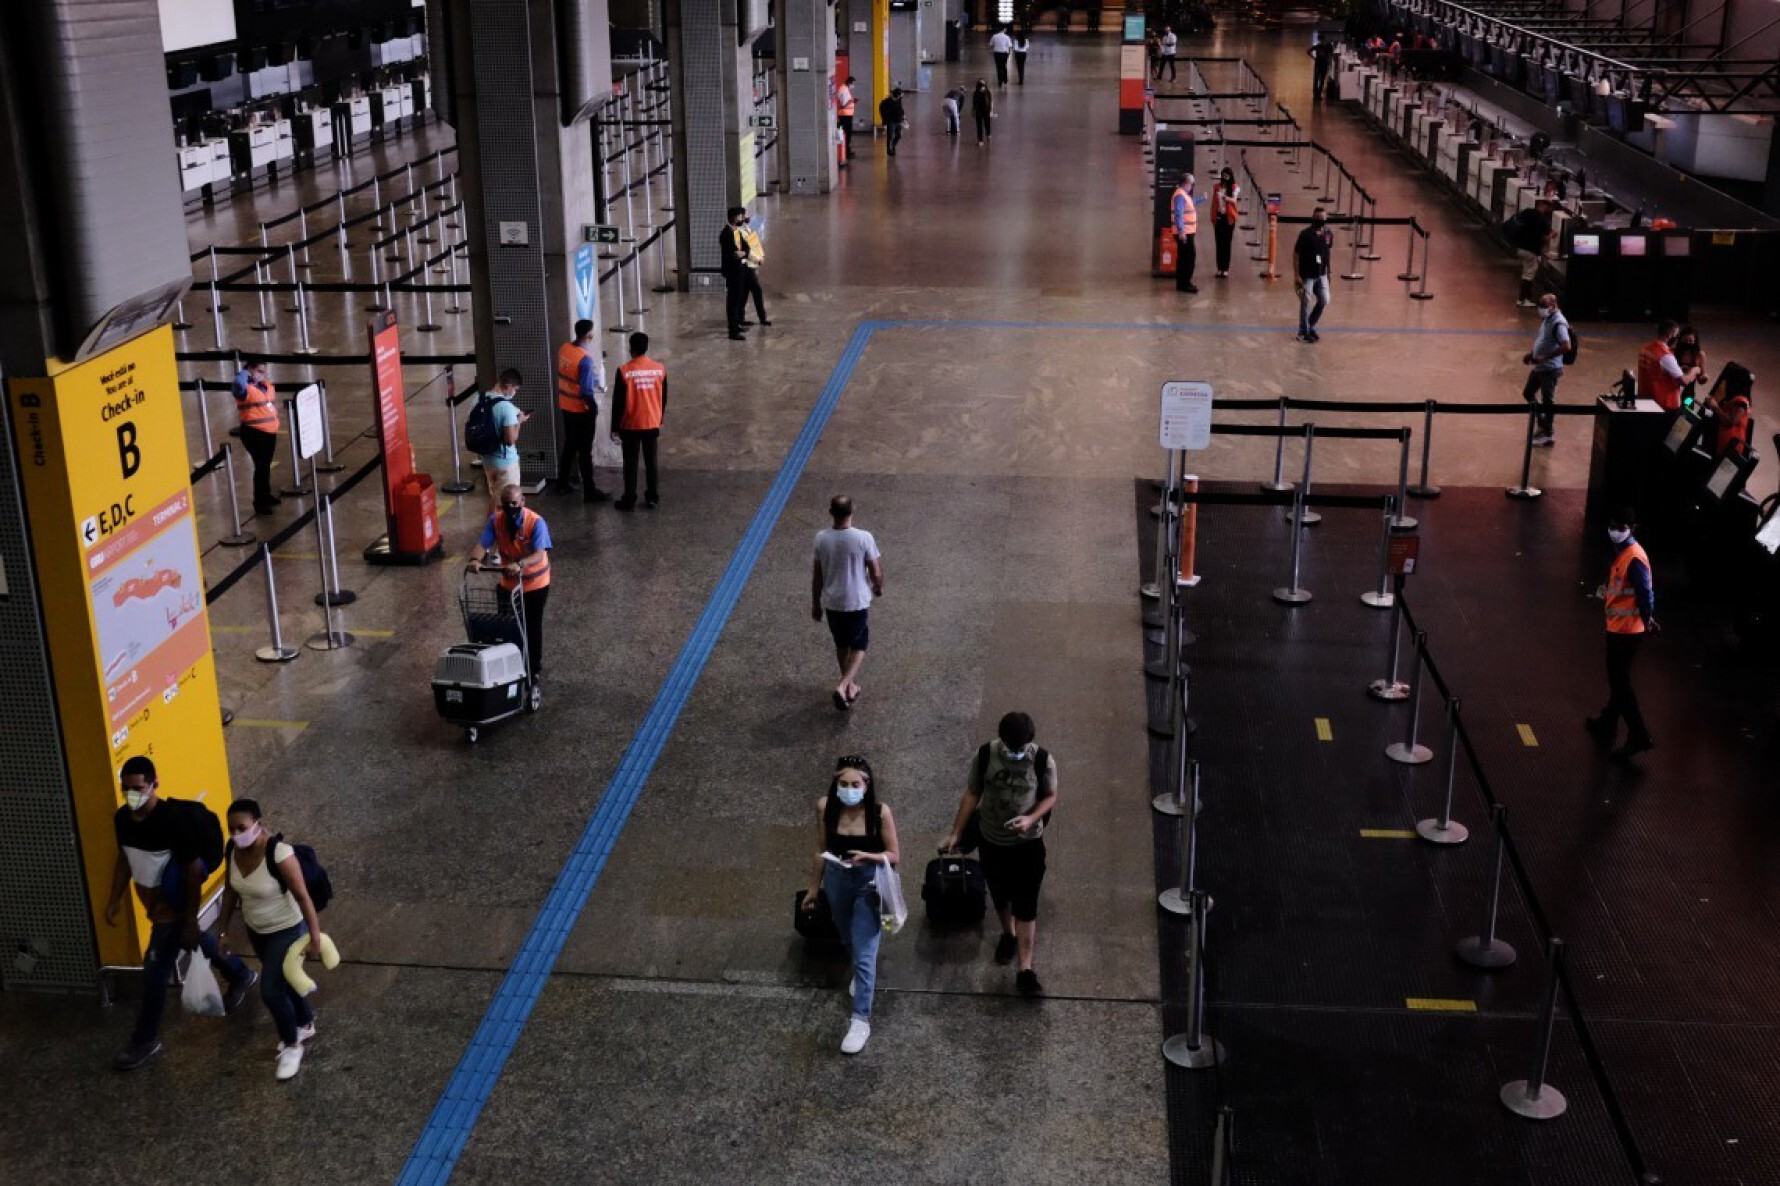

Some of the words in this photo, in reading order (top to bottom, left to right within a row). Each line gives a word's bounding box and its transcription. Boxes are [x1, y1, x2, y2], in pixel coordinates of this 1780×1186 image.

[20, 393, 41, 408] B
[101, 389, 145, 422] Check-in
[27, 412, 46, 467] Check-in
[116, 420, 141, 480] B
[98, 493, 135, 535] E,D,C
